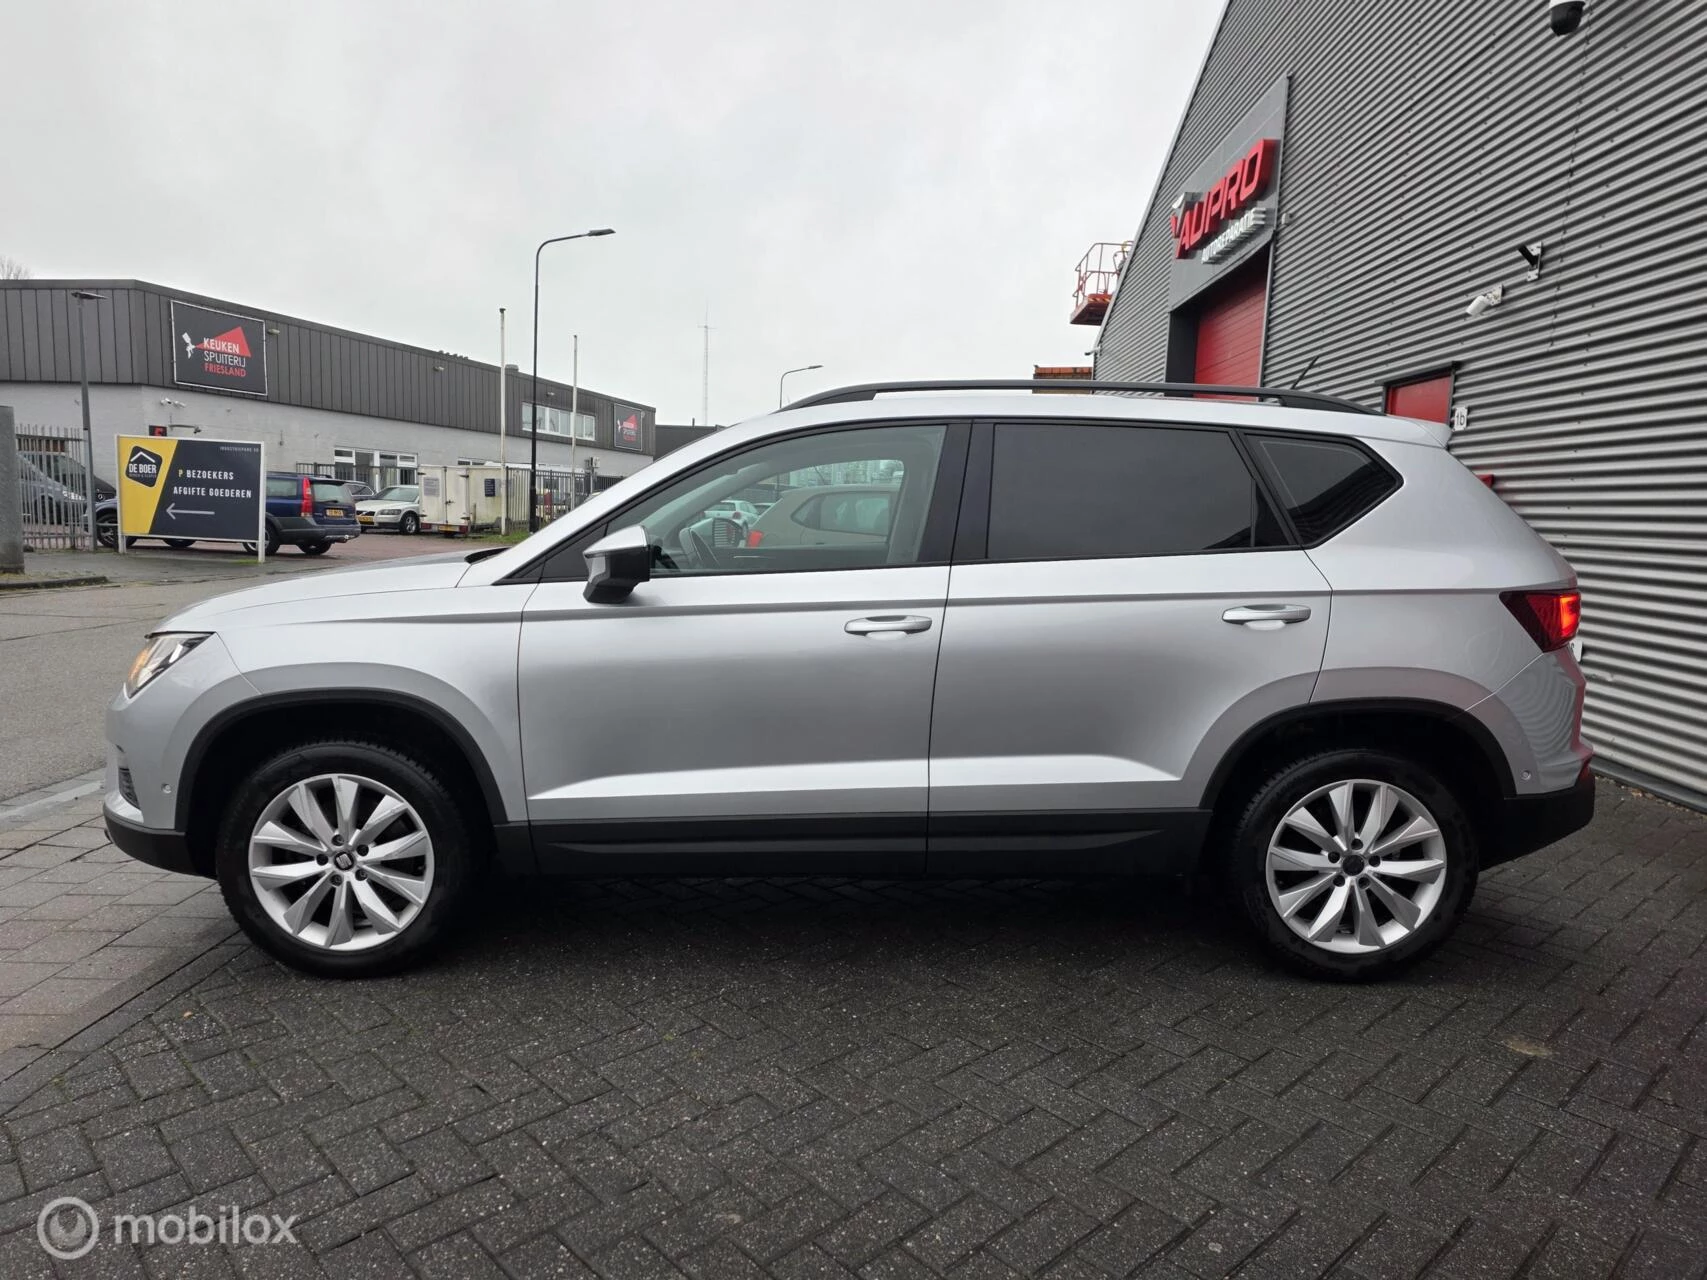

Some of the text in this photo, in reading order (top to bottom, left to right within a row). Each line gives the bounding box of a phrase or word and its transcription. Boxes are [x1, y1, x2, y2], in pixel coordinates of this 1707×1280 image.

[203, 337, 240, 354] KEUKEN
[203, 350, 246, 367] SPUITERIJ
[204, 363, 247, 377] FRIESLAND
[128, 463, 157, 474] DE BOER
[178, 469, 235, 480] P BEZOEKERS
[173, 486, 252, 499] AFGIFTE GOEDEREN
